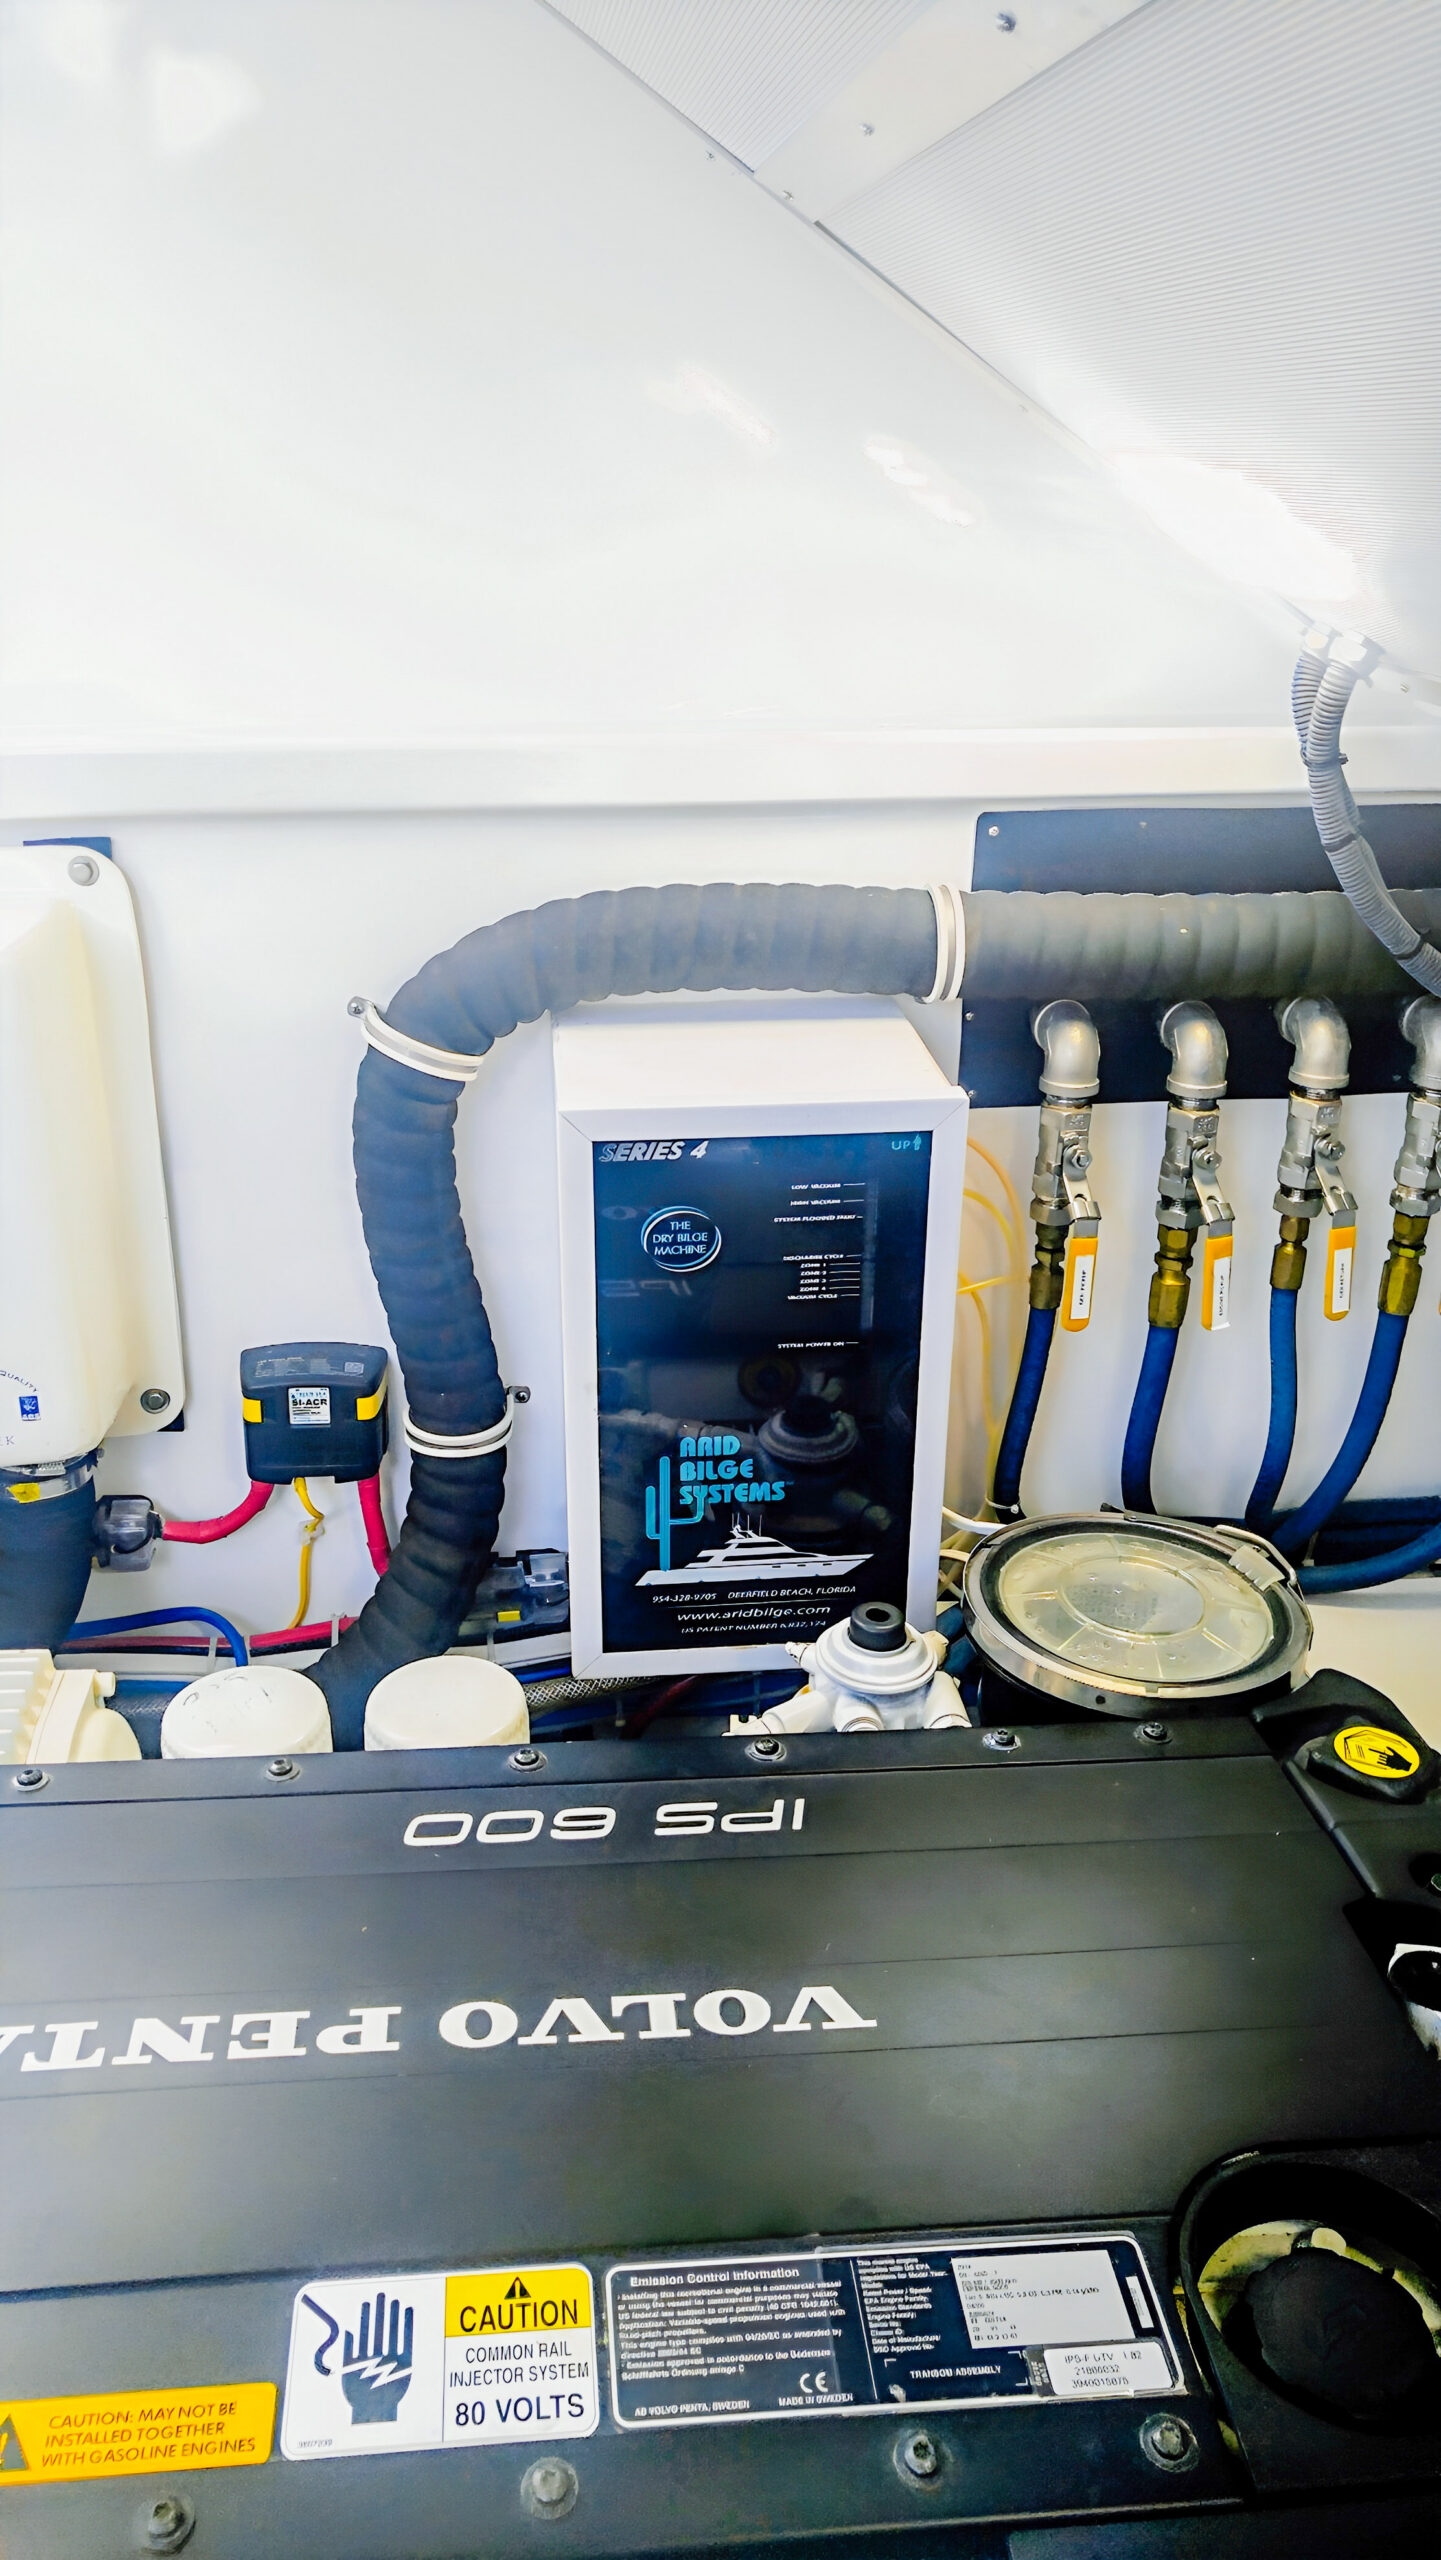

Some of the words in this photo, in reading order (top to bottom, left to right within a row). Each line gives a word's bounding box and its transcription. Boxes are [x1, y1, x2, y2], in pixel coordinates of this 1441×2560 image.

[598, 1140, 686, 1162] SERIES
[690, 1140, 709, 1159] 4
[891, 1140, 911, 1150] UP
[670, 1221, 691, 1231] THE
[652, 1234, 673, 1244] DRY
[677, 1232, 708, 1242] BILGE
[654, 1244, 707, 1255] MACHINE
[680, 1435, 741, 1457] ARID
[680, 1459, 753, 1481] BILGE
[680, 1481, 785, 1505] SYSTEMS
[728, 1589, 778, 1599] DEERFIELD
[780, 1587, 813, 1597] BEACH,
[815, 1586, 856, 1595] FLORIDA
[677, 1606, 831, 1621] www.aridbilge.com
[736, 1622, 778, 1631] NUMBER
[404, 1806, 617, 1848] 600
[653, 1799, 806, 1836] IPS
[438, 1986, 878, 2050] VOLVO
[630, 2275, 684, 2287] Emission
[687, 2271, 730, 2284] Control
[732, 2267, 800, 2281] Information
[460, 2299, 578, 2333] CAUTION
[465, 2343, 534, 2364] COMMON
[538, 2341, 572, 2358] RAIL
[449, 2368, 524, 2388] INJECTOR
[528, 2363, 589, 2381] SYSTEM
[49, 2410, 134, 2429] CAUTION:
[139, 2406, 176, 2422] MAY
[178, 2403, 215, 2418] NOT
[218, 2401, 238, 2415] BE
[455, 2401, 486, 2426] 80
[495, 2393, 585, 2423] VOLTS
[45, 2429, 132, 2448] INSTALLED
[137, 2422, 225, 2441] TOGETHER
[42, 2451, 85, 2468] WITH
[89, 2443, 177, 2464] GASOLINE
[181, 2438, 257, 2457] ENGINES
